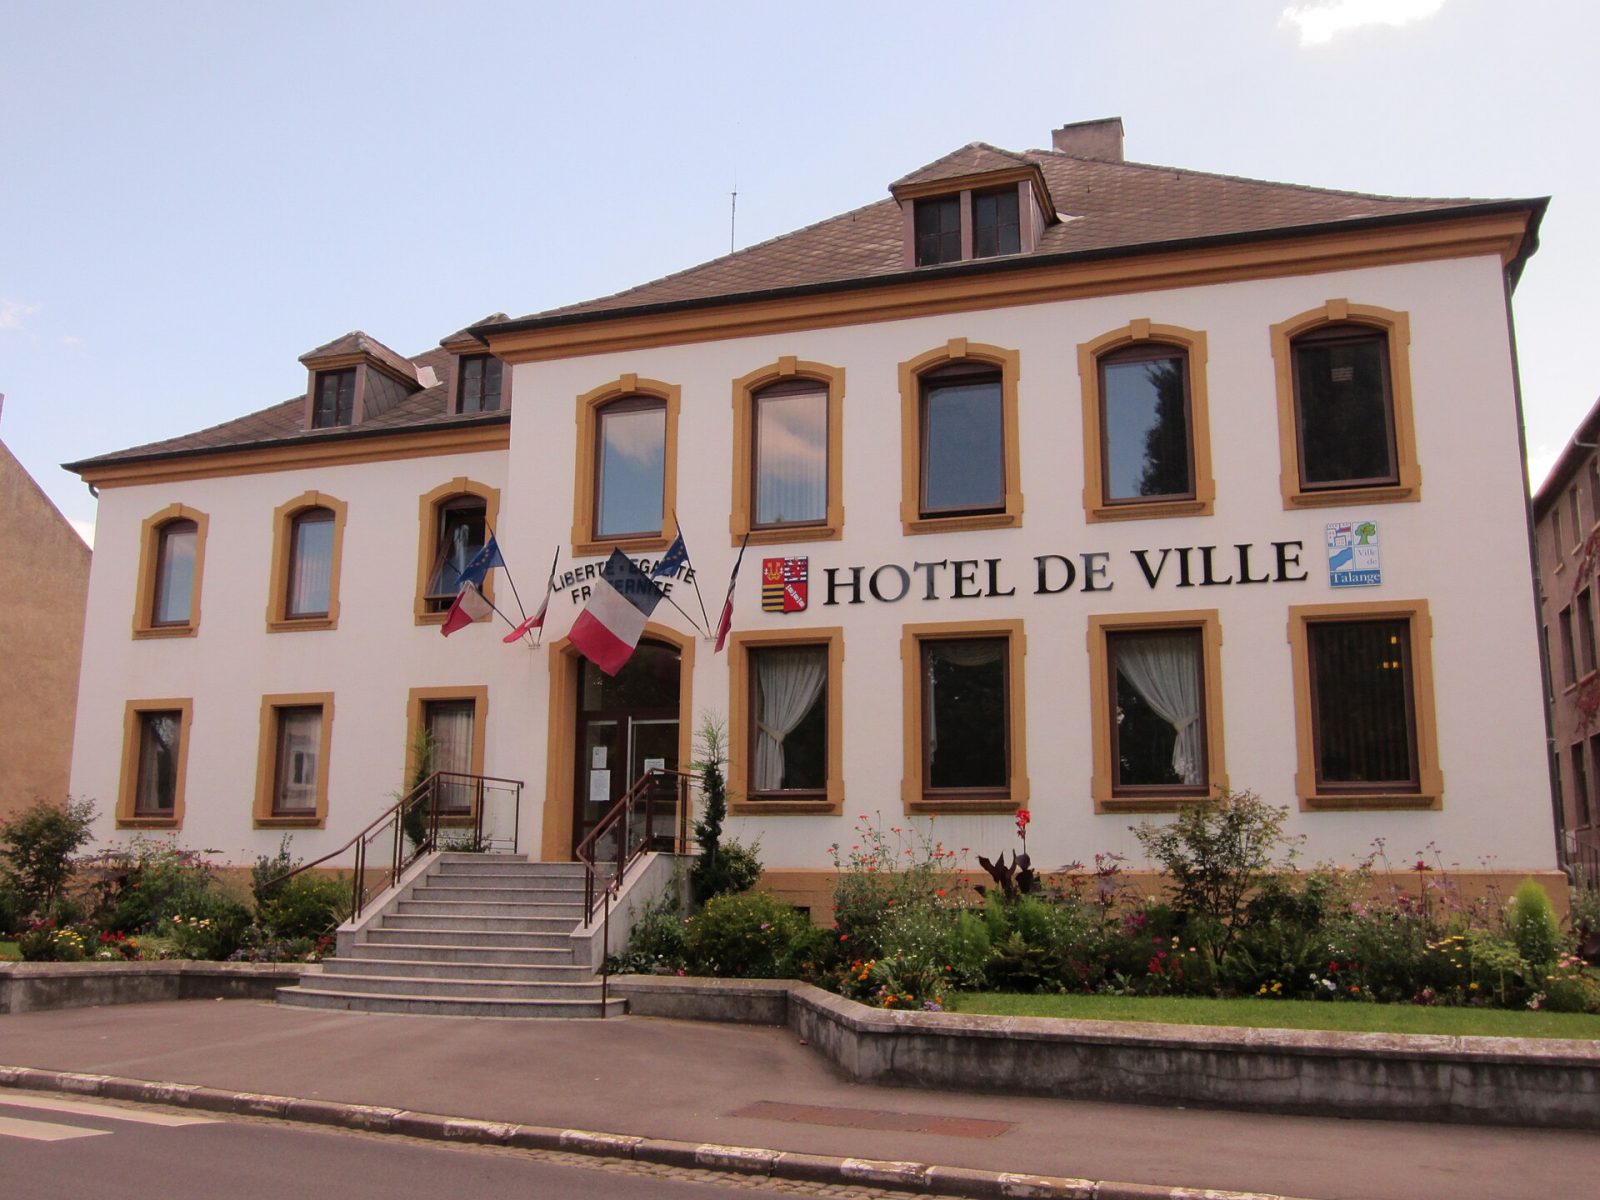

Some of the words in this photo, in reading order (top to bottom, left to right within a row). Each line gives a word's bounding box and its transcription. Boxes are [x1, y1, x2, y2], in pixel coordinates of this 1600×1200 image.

[629, 558, 696, 584] EGATE
[823, 558, 1015, 605] HOTEL
[1033, 552, 1114, 594] DE
[1130, 541, 1309, 589] VILLE
[1331, 571, 1380, 584] Talange
[571, 579, 674, 604] FRERNITE
